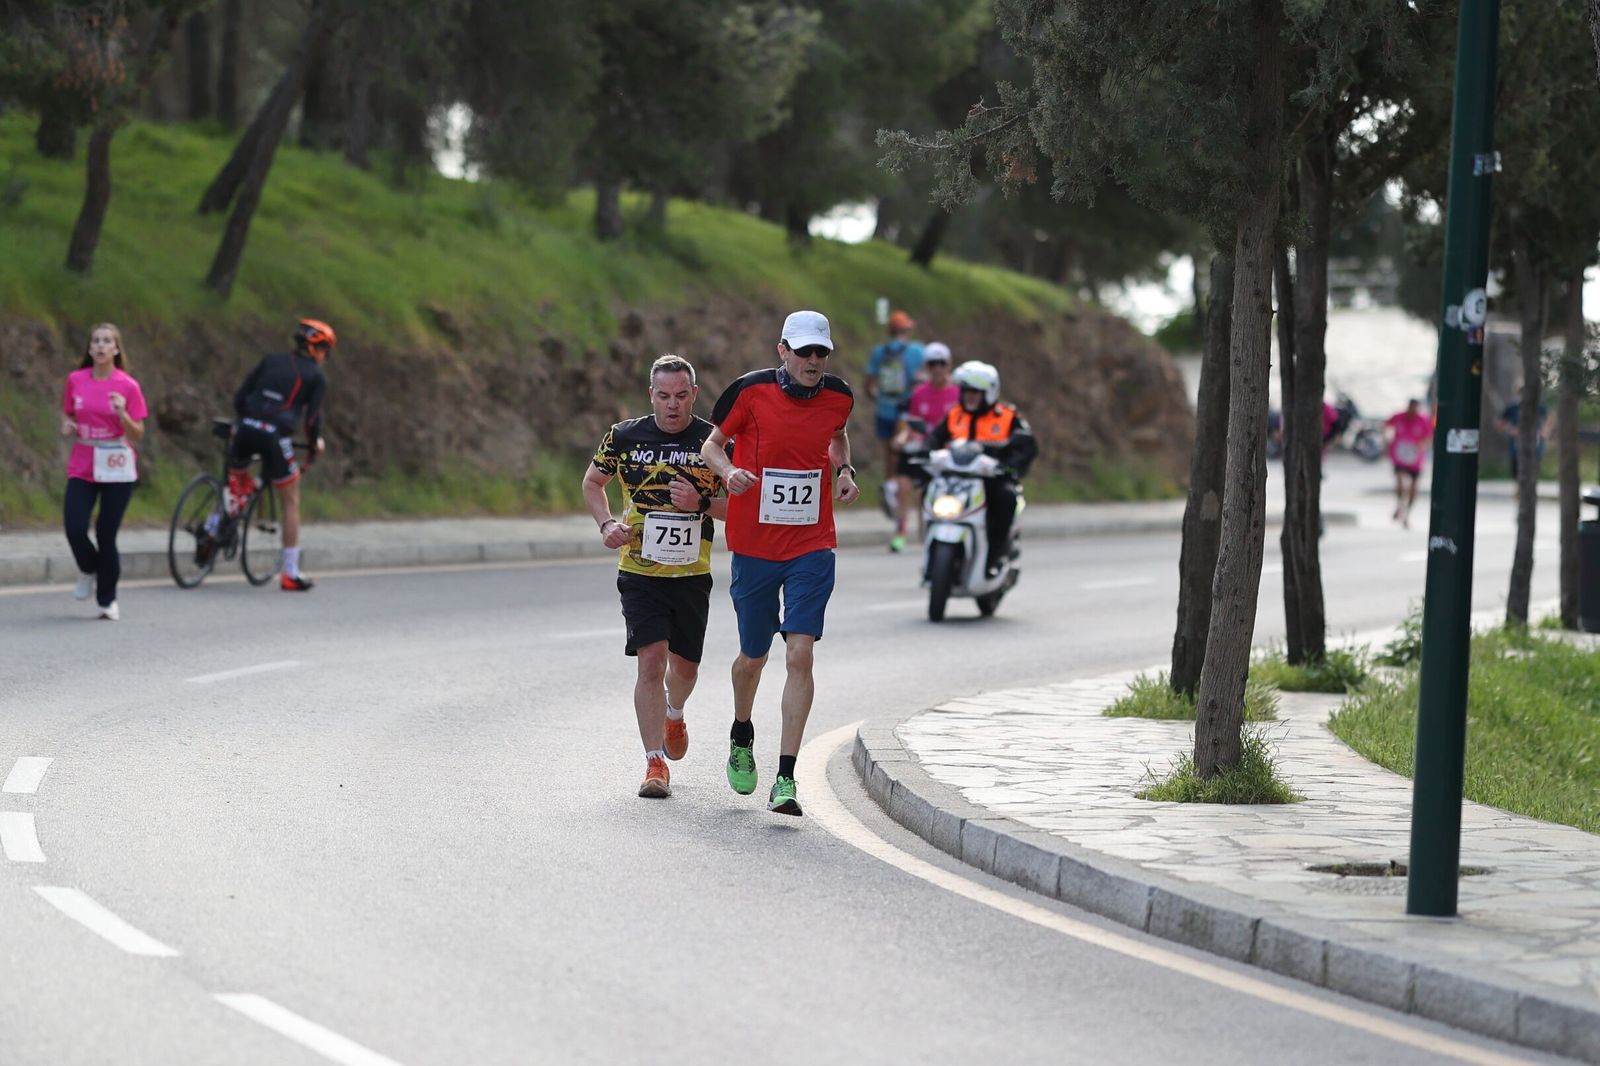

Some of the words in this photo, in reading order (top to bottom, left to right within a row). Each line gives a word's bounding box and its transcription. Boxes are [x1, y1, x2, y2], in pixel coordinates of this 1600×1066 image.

[107, 453, 126, 469] 60
[631, 450, 654, 464] NO
[772, 484, 813, 505] 512
[655, 525, 693, 546] 751
